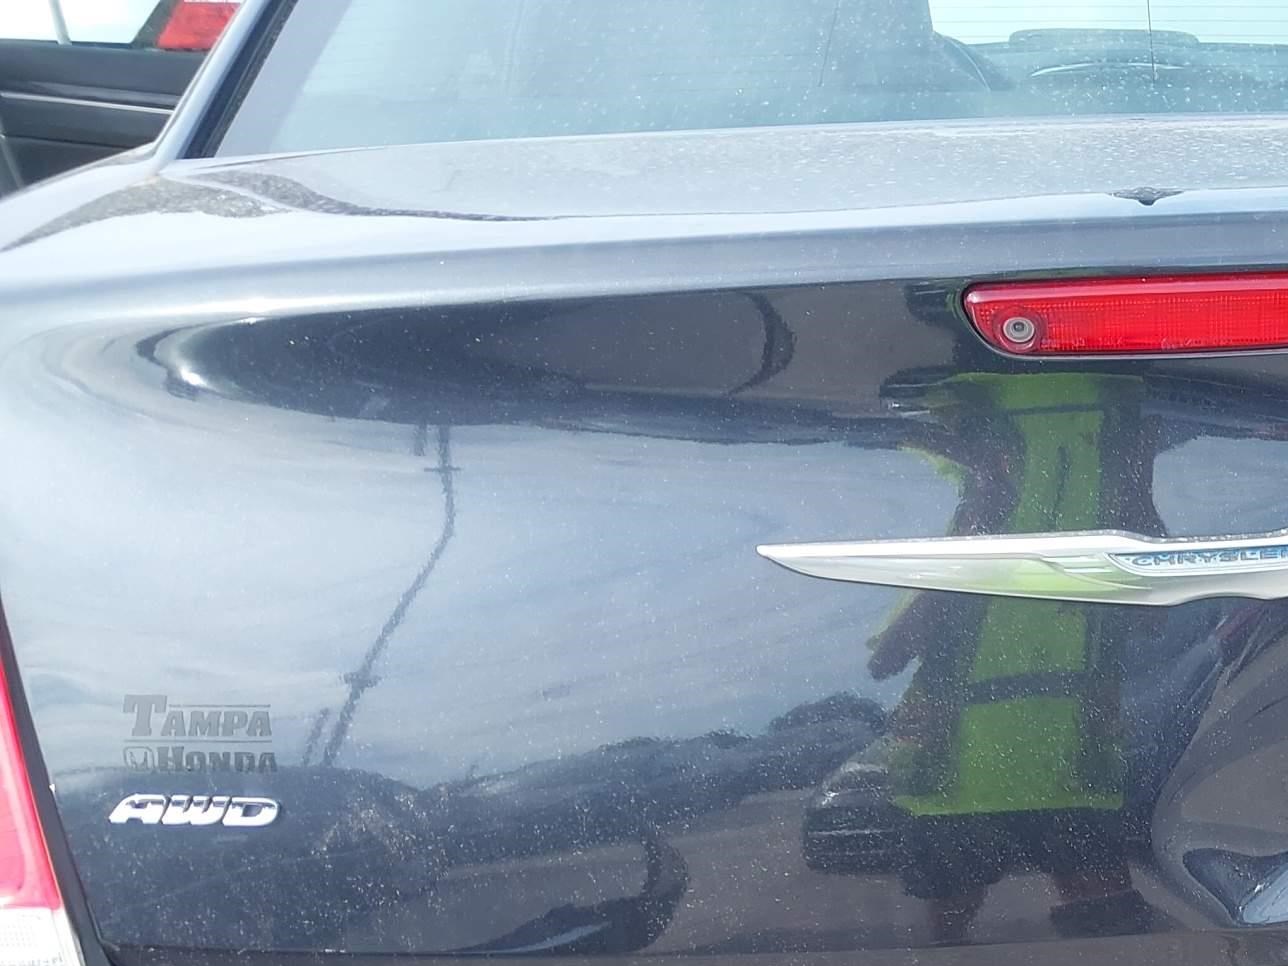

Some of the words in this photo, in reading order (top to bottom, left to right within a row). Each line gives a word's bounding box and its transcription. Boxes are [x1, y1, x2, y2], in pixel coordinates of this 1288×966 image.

[122, 694, 273, 737] TAMPA
[155, 746, 278, 773] HONDA
[108, 793, 282, 827] AWD
